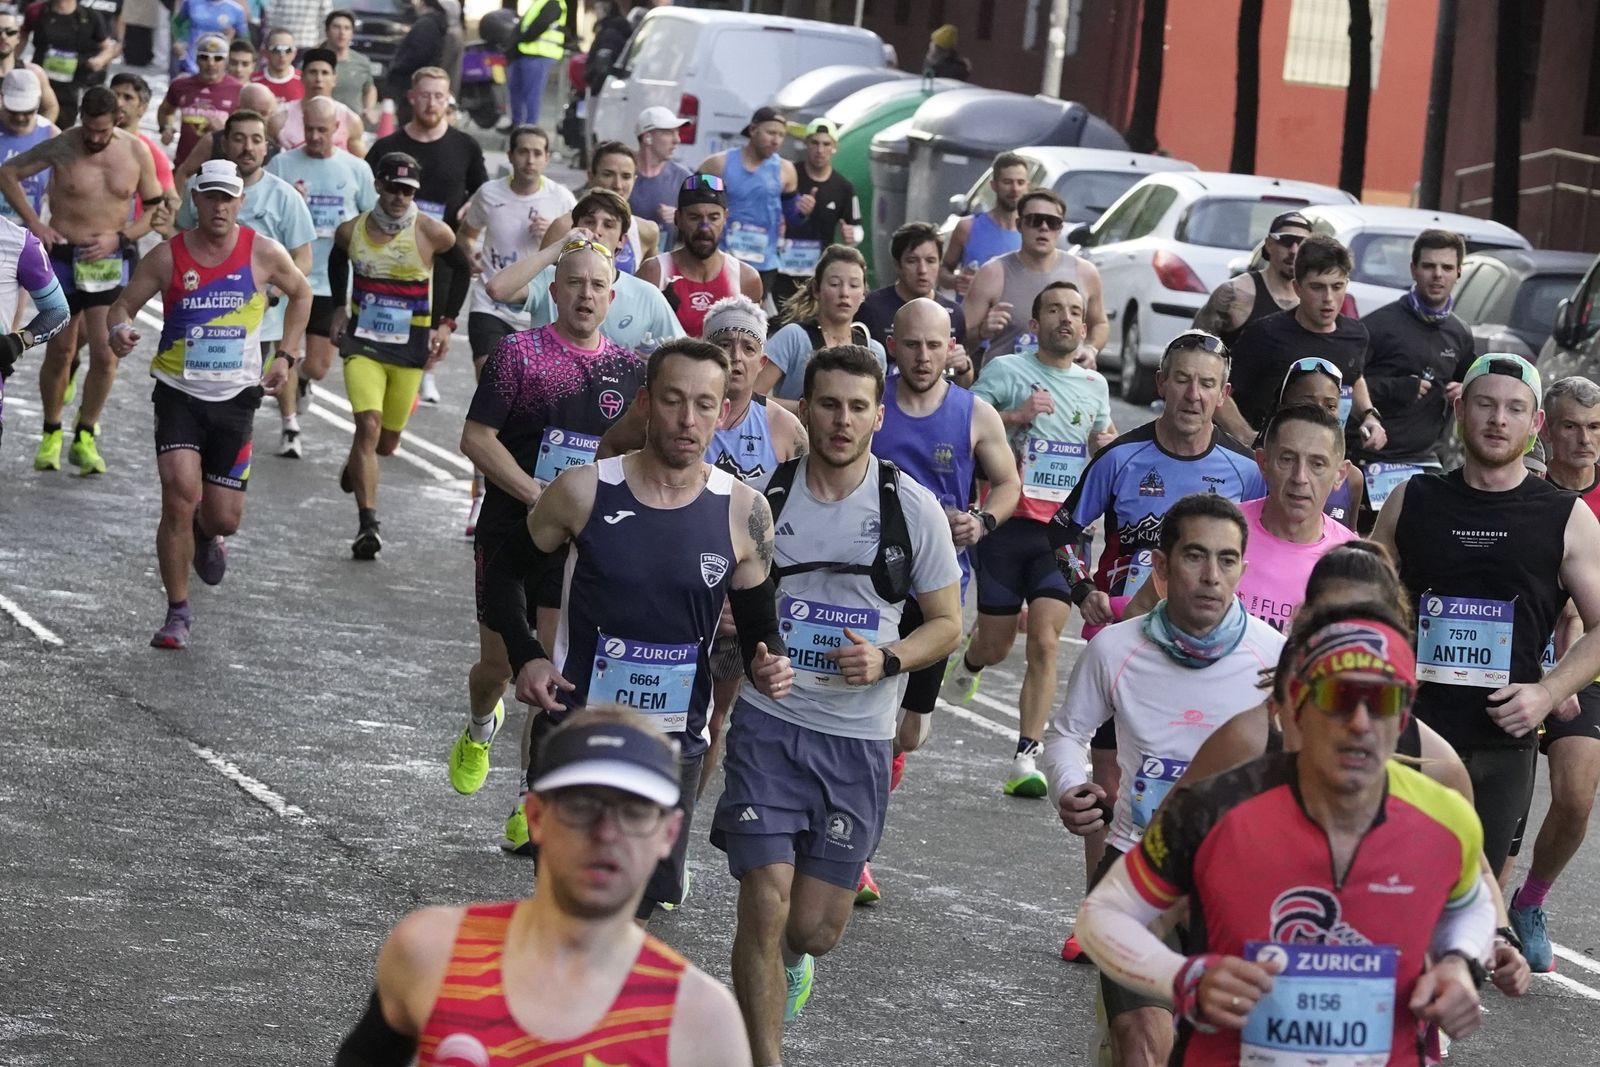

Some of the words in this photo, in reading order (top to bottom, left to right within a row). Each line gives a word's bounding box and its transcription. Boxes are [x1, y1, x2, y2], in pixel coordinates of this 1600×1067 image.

[183, 297, 243, 309] PALACIEGO
[377, 299, 408, 308] ZURICH
[207, 329, 241, 337] ZURICH
[373, 321, 395, 332] VITO
[185, 360, 210, 368] FRANK
[1052, 444, 1081, 454] ZURICH
[1050, 462, 1068, 470] 6730
[1033, 471, 1077, 487] MELERO
[815, 608, 868, 624] ZURICH
[1448, 603, 1502, 617] ZURICH
[812, 633, 841, 648] 8443
[1448, 628, 1477, 641] 7570
[632, 646, 688, 660] ZURICH
[1432, 644, 1492, 665] ANTHO
[629, 673, 660, 687] 6664
[615, 688, 667, 710] CLEM
[1296, 953, 1381, 972] ZURICH
[1296, 993, 1341, 1011] 8156
[1266, 1017, 1367, 1047] KANIJO
